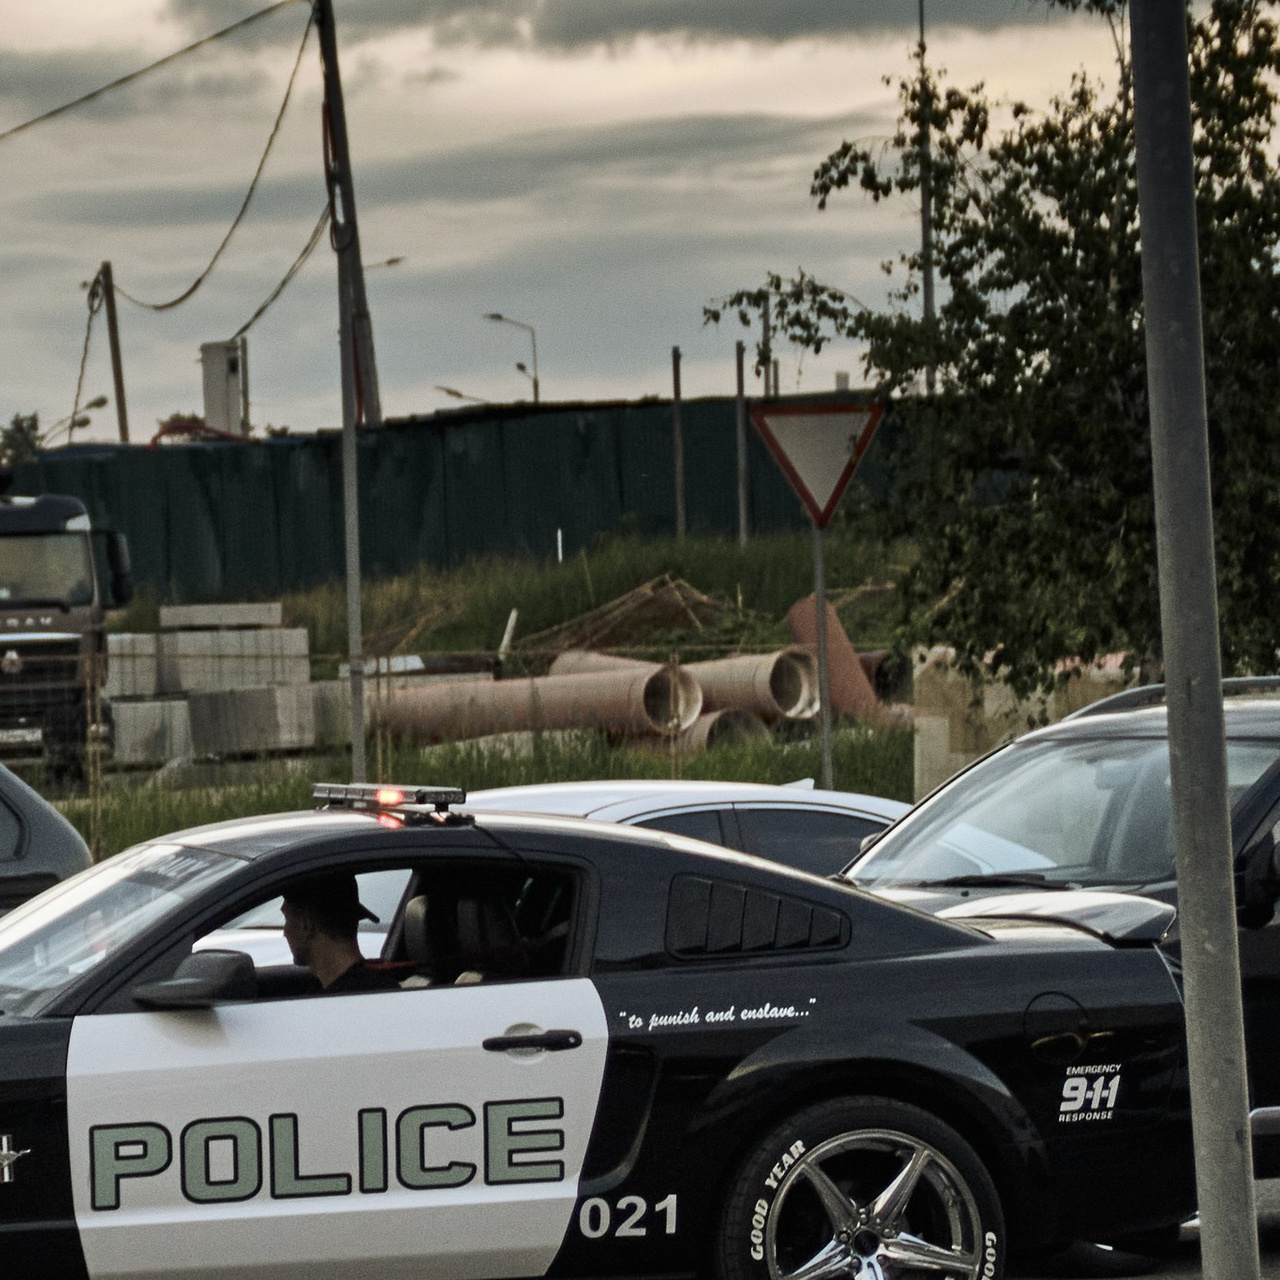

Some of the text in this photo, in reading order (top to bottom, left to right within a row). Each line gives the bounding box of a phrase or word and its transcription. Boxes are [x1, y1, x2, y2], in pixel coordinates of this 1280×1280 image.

[648, 1005, 700, 1032] punish
[704, 1005, 735, 1023] and
[1065, 1064, 1122, 1076] EMERGENCY
[1058, 1110, 1114, 1122] RESPONSE
[89, 1096, 565, 1211] POLICE
[579, 1194, 677, 1239] 021
[750, 1139, 806, 1261] GOOD YEAR
